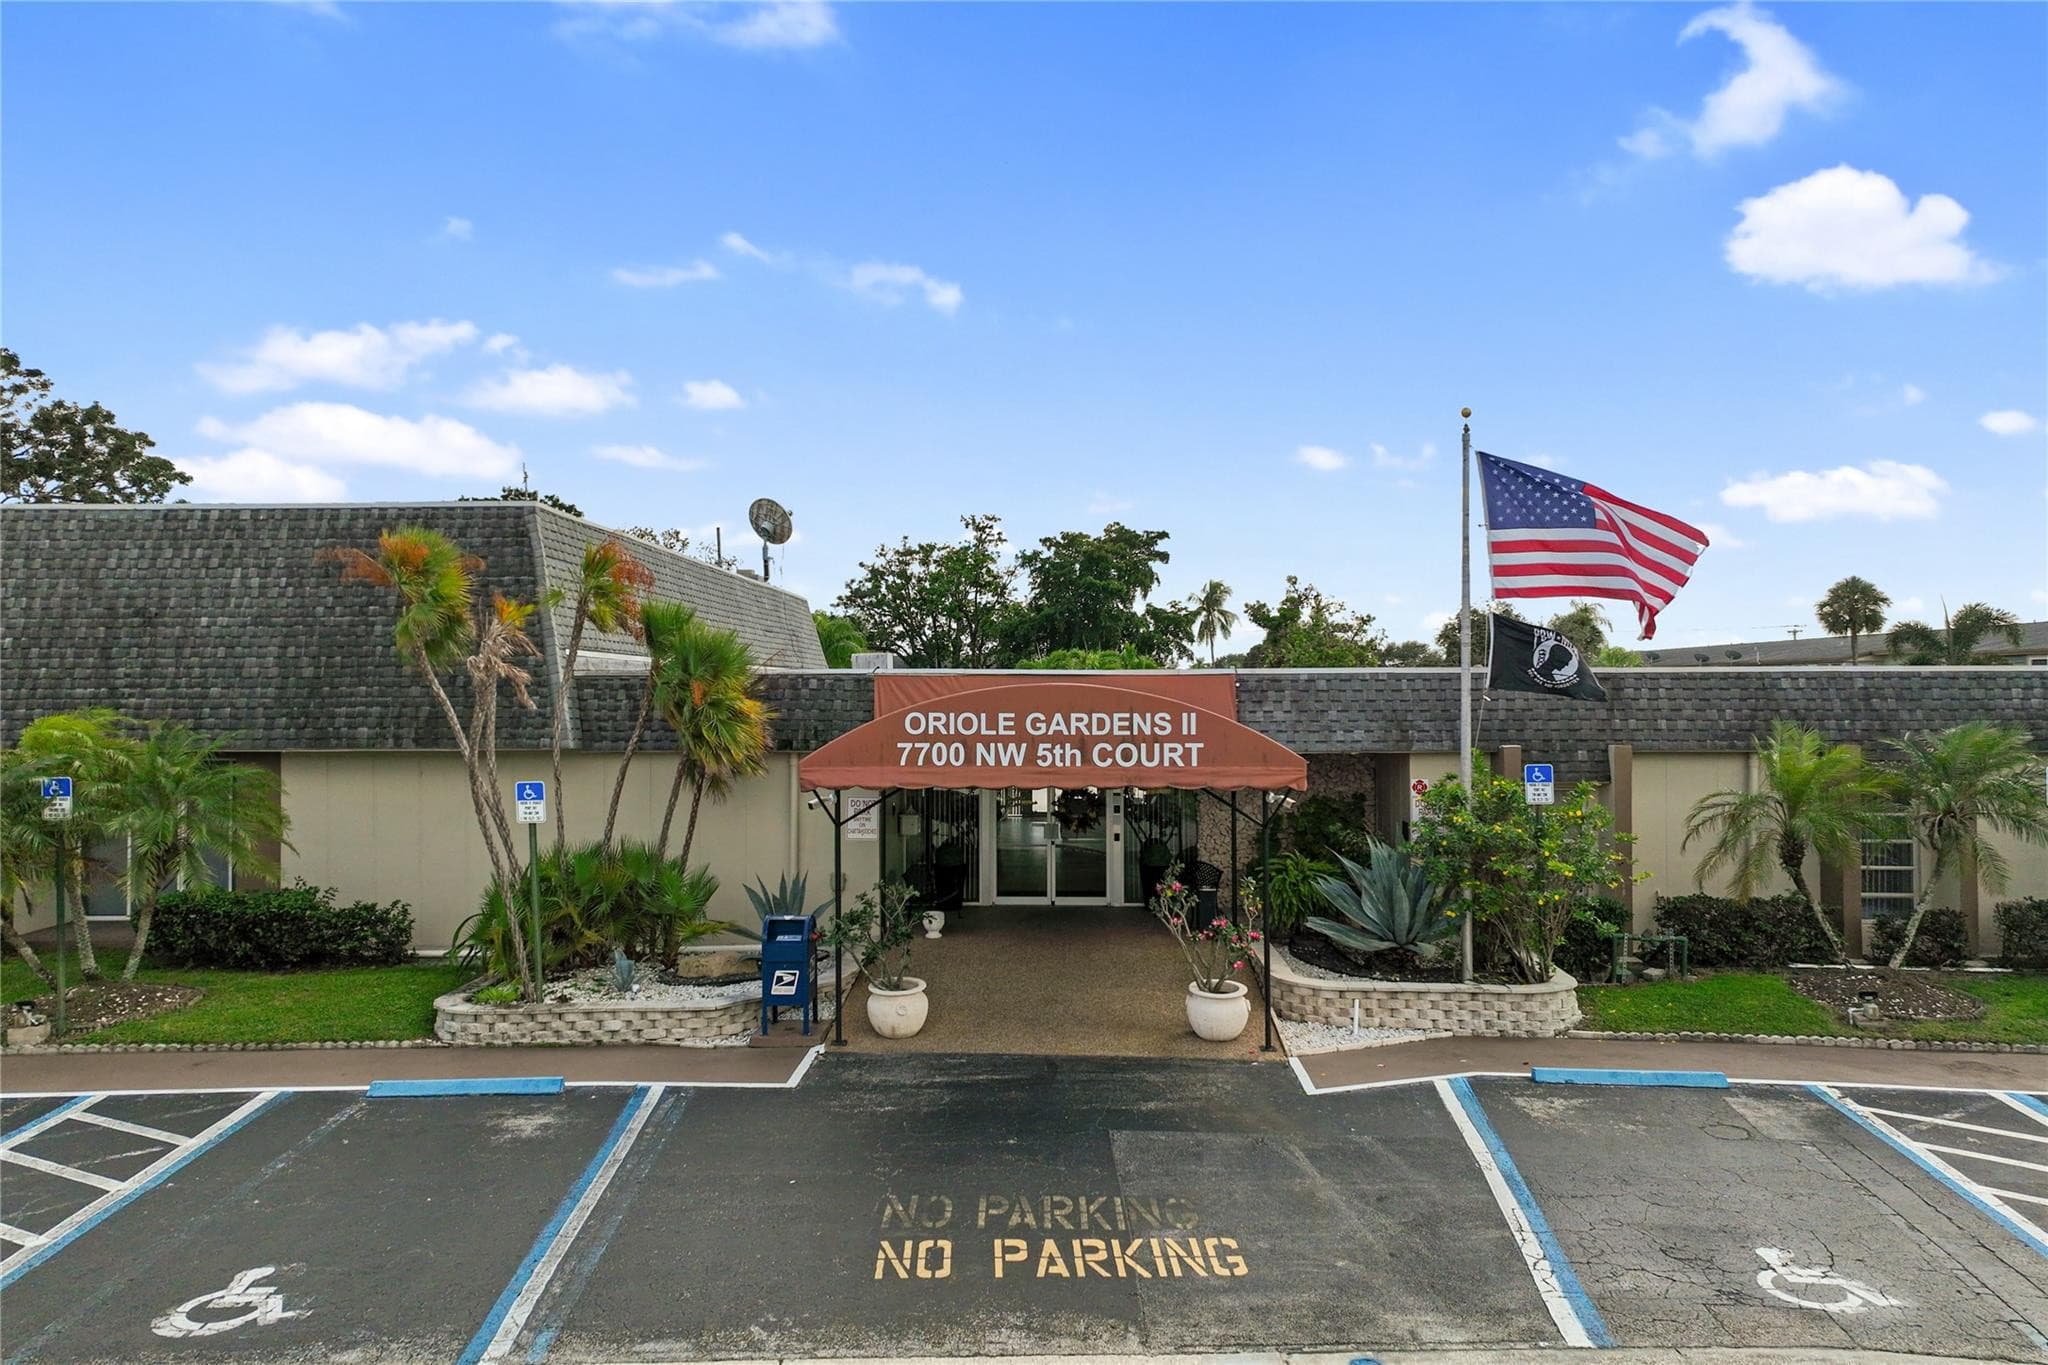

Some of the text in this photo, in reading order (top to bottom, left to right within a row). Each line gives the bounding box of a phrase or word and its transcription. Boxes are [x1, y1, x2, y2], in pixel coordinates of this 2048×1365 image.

[904, 712, 1197, 735] ORIOLE GARDENS II
[897, 742, 1204, 767] 7700 NW 5th COURT
[850, 799, 861, 807] DO
[854, 808, 872, 816] PK
[880, 1194, 1199, 1230] NO PARKING
[874, 1238, 1249, 1280] NO PARKING
